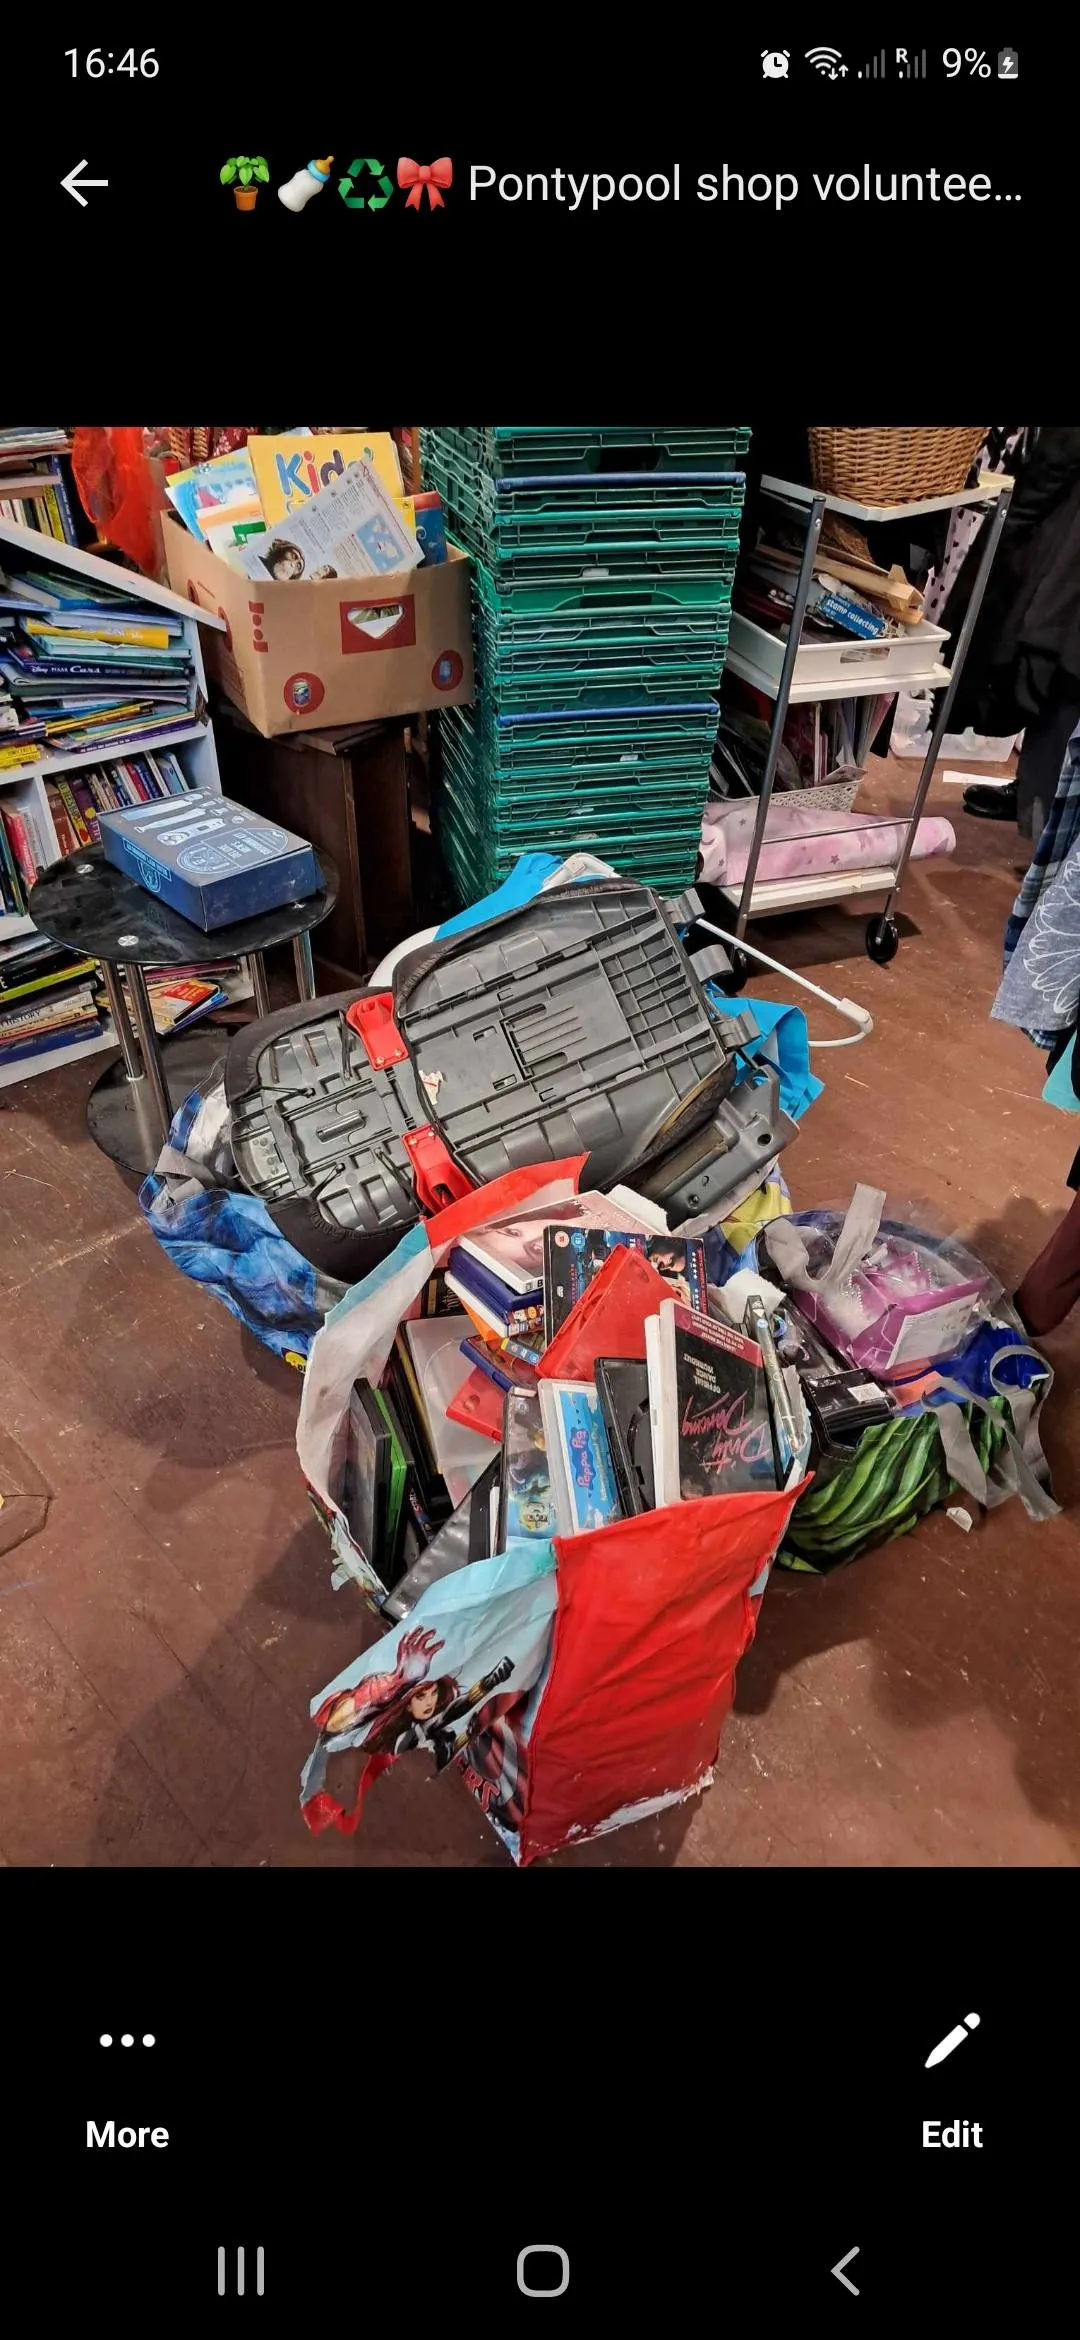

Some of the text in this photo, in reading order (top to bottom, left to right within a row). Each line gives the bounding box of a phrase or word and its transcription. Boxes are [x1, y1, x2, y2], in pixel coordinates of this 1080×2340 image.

[826, 600, 848, 615] stamp
[847, 611, 879, 636] collecting
[683, 1353, 714, 1374] WORKOUT
[695, 1367, 717, 1383] DANCE
[681, 1388, 753, 1437] Dancing
[572, 1430, 593, 1487] Peppa Pig
[699, 1420, 770, 1475] Dirty
